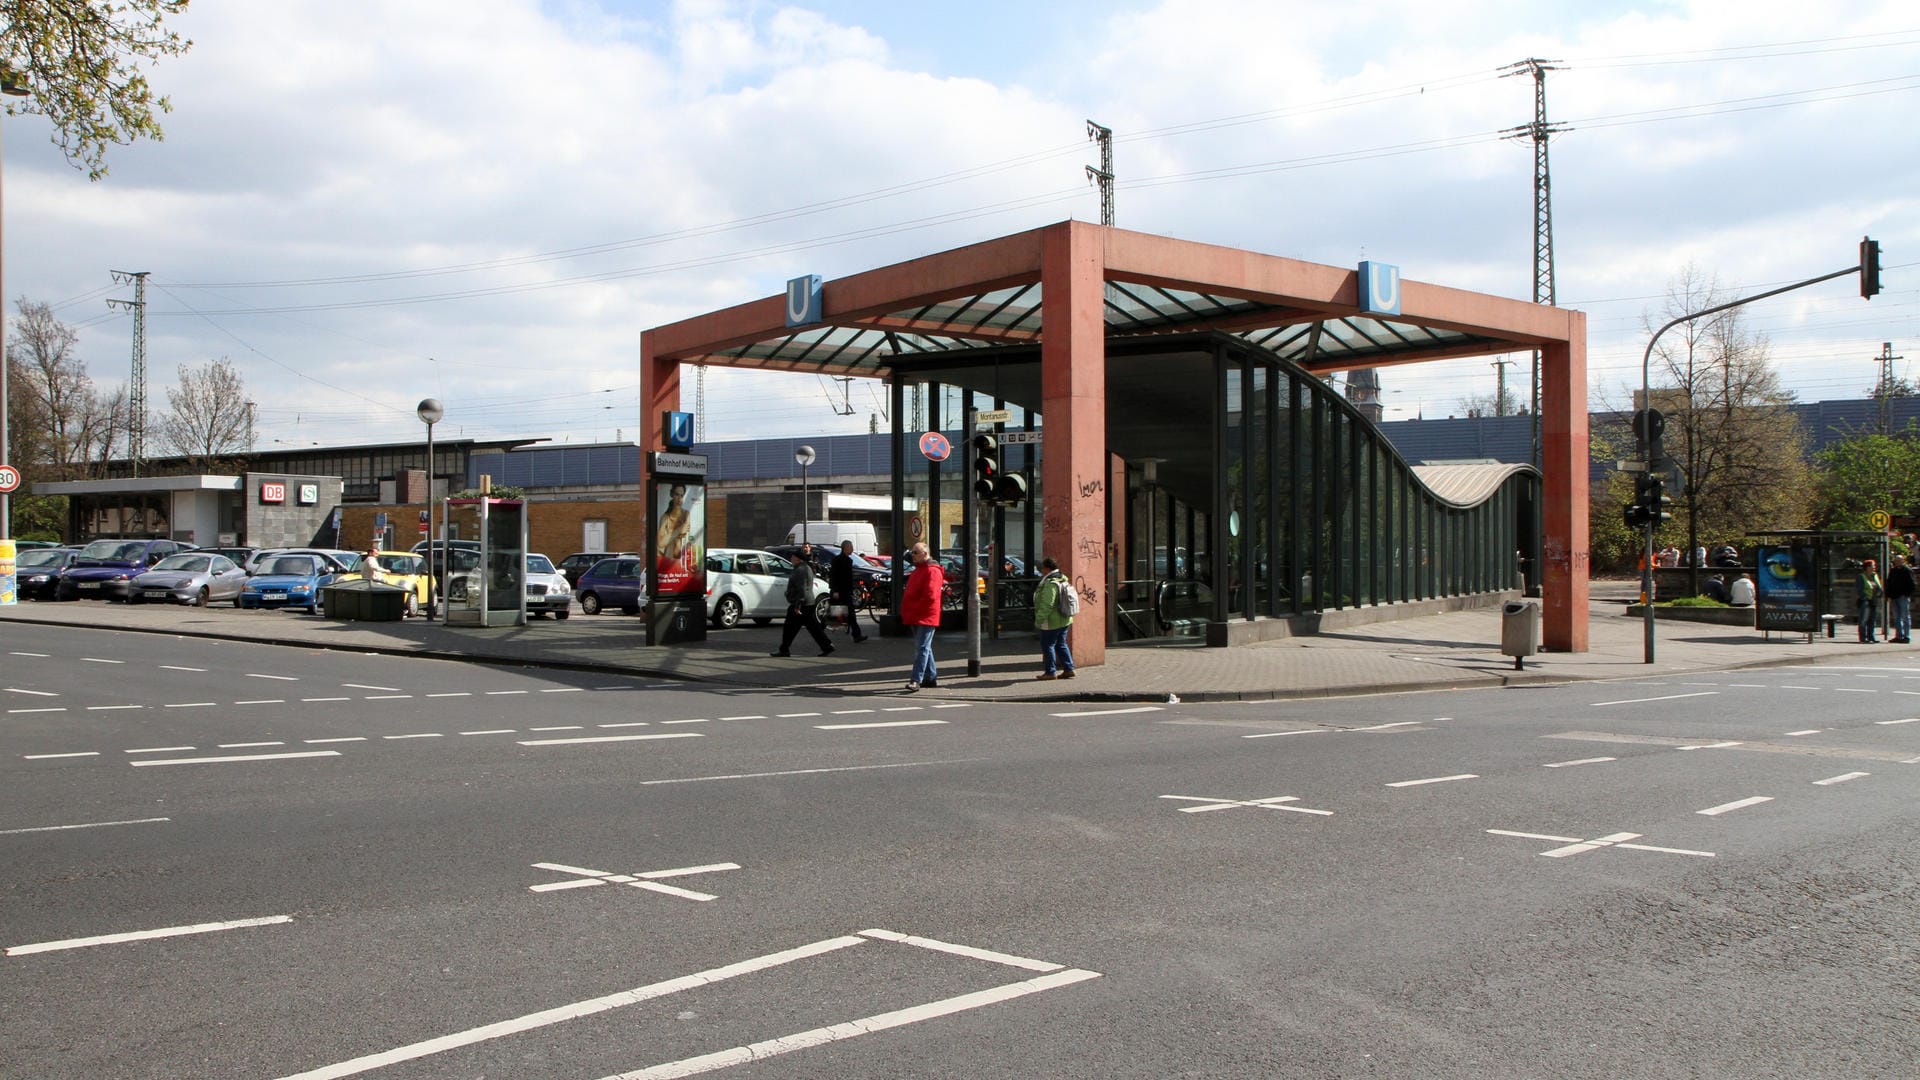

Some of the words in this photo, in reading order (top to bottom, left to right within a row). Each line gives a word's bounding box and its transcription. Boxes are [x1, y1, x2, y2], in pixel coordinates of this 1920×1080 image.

[1372, 264, 1397, 311] U
[789, 277, 809, 323] U
[675, 416, 689, 442] U
[657, 458, 681, 468] Bahnhof
[682, 459, 706, 470] Mülheim
[266, 486, 283, 499] DB
[304, 487, 315, 500] S
[1874, 515, 1884, 526] H
[1765, 612, 1808, 621] AVATAR
